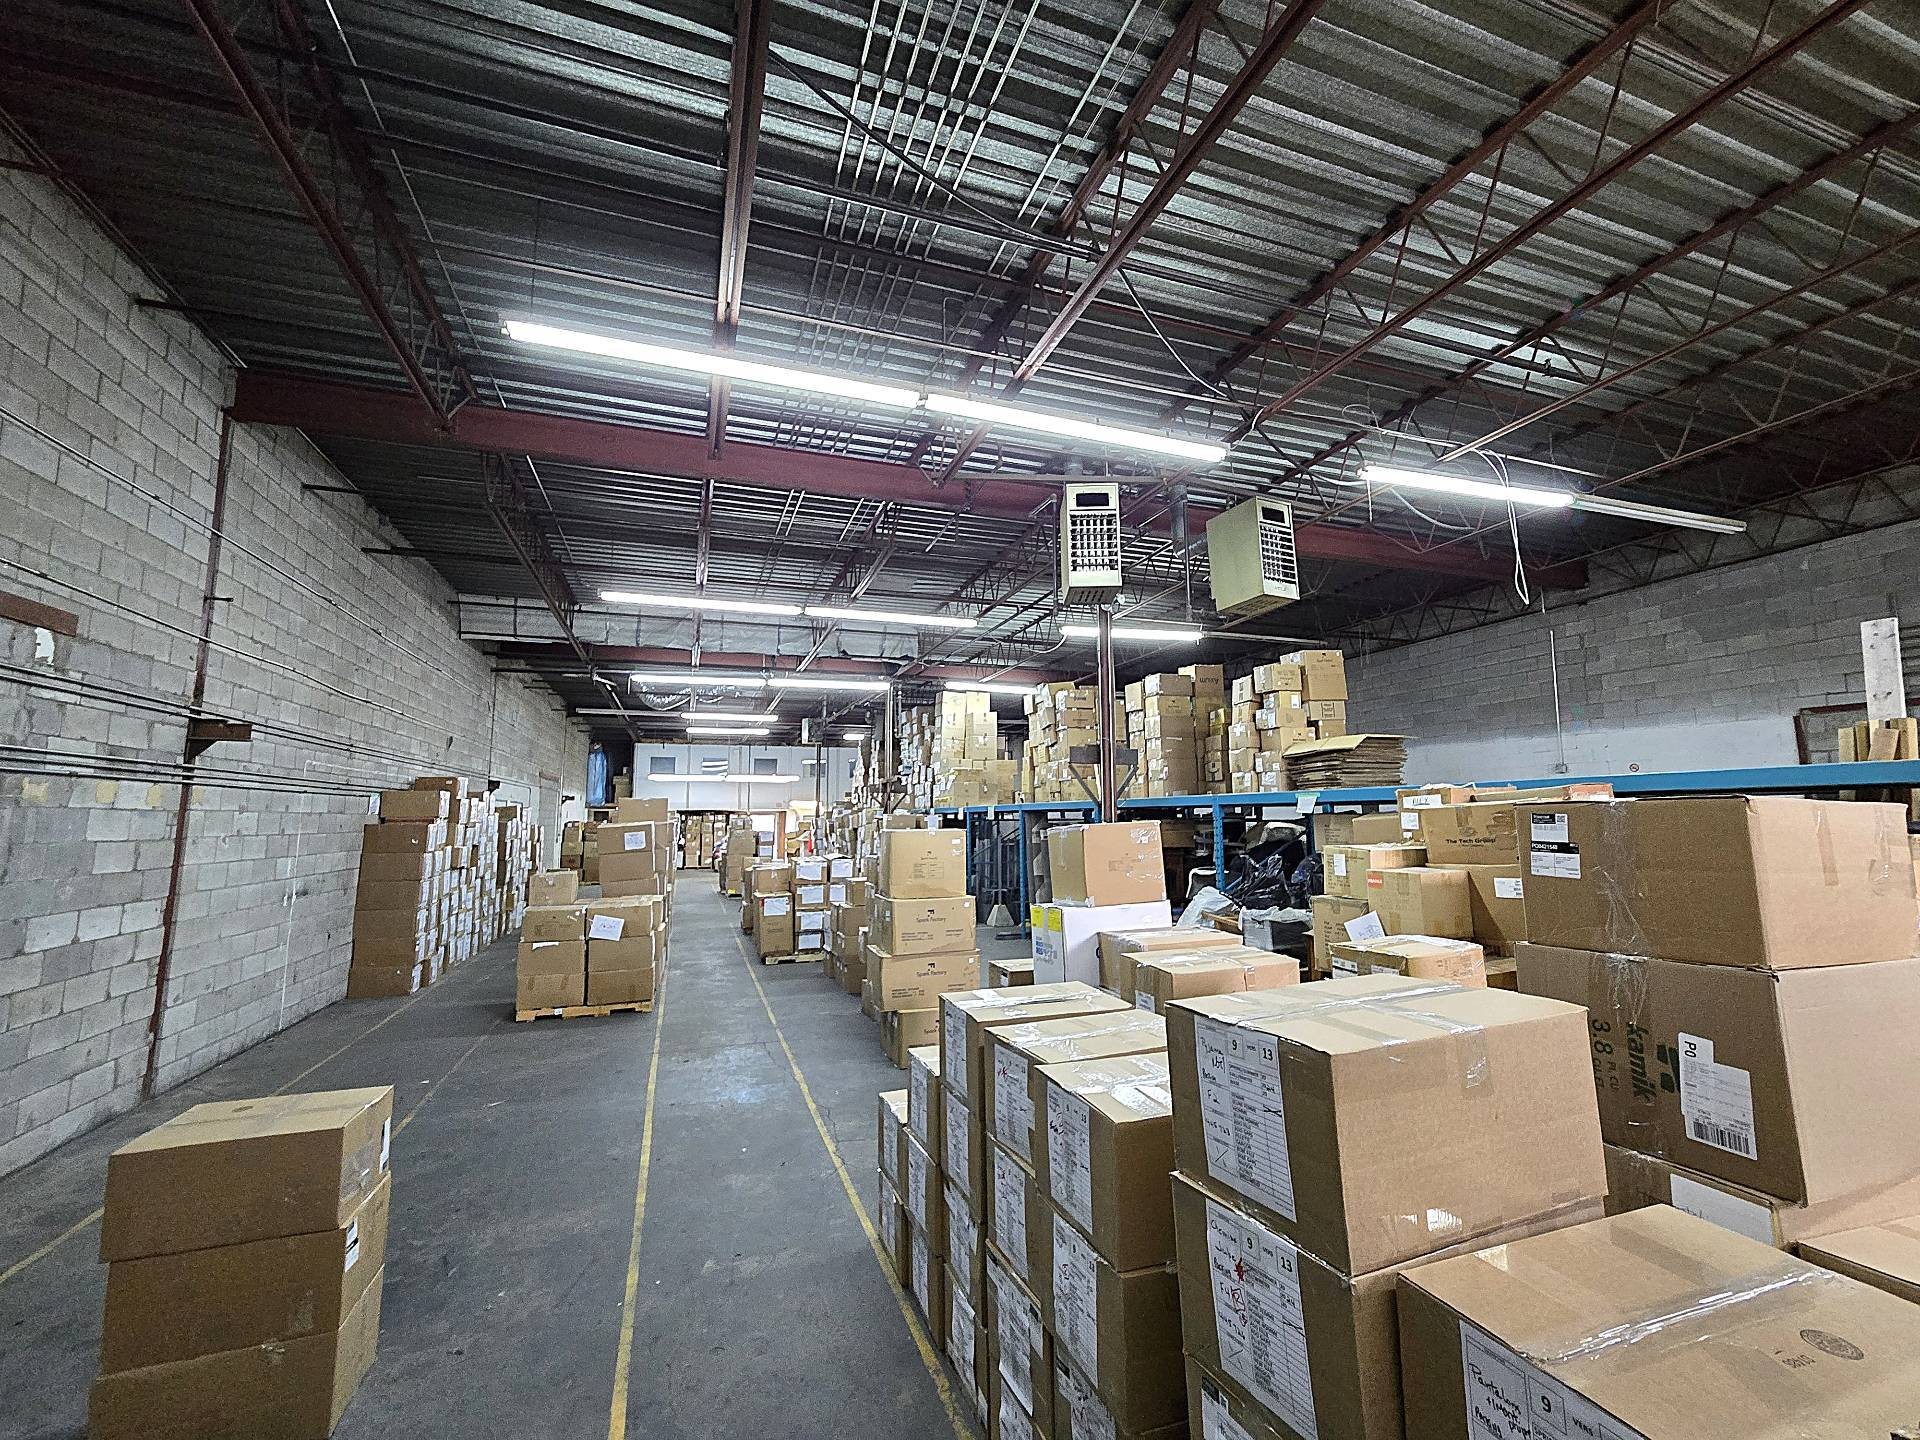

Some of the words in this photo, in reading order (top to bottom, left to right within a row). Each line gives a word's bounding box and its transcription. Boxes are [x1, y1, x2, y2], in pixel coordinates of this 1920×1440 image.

[1231, 1039, 1238, 1051] 9
[1262, 1047, 1274, 1061] 13
[1626, 1022, 1657, 1099] kamik
[1246, 1237, 1253, 1249] 9
[1280, 1256, 1293, 1273] 13
[1540, 1394, 1552, 1413] 9
[1572, 1415, 1594, 1437] VERS
